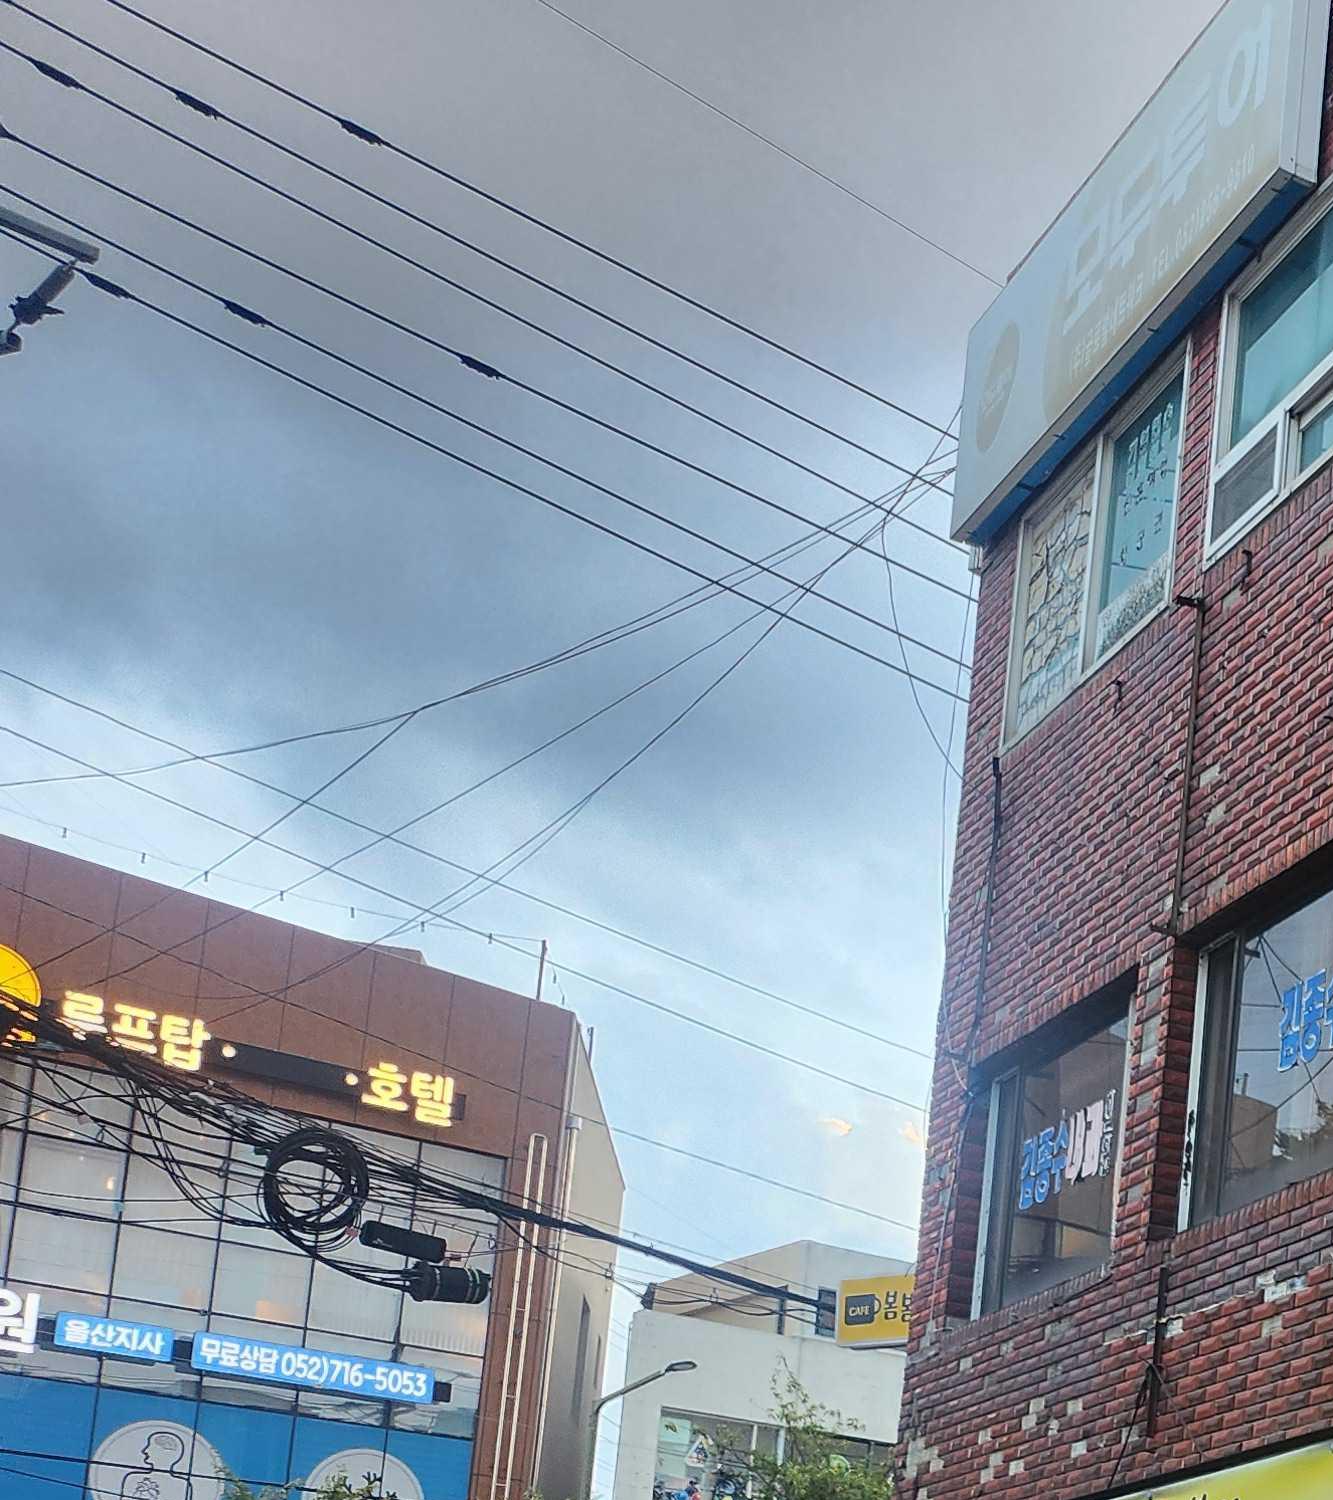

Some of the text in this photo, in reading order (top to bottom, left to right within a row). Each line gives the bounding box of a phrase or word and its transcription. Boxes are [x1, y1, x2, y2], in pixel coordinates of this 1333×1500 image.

[361, 1062, 457, 1128] 호텔
[64, 1320, 166, 1358] 울산지사
[199, 1338, 428, 1399] 무료상담 052)716-5053
